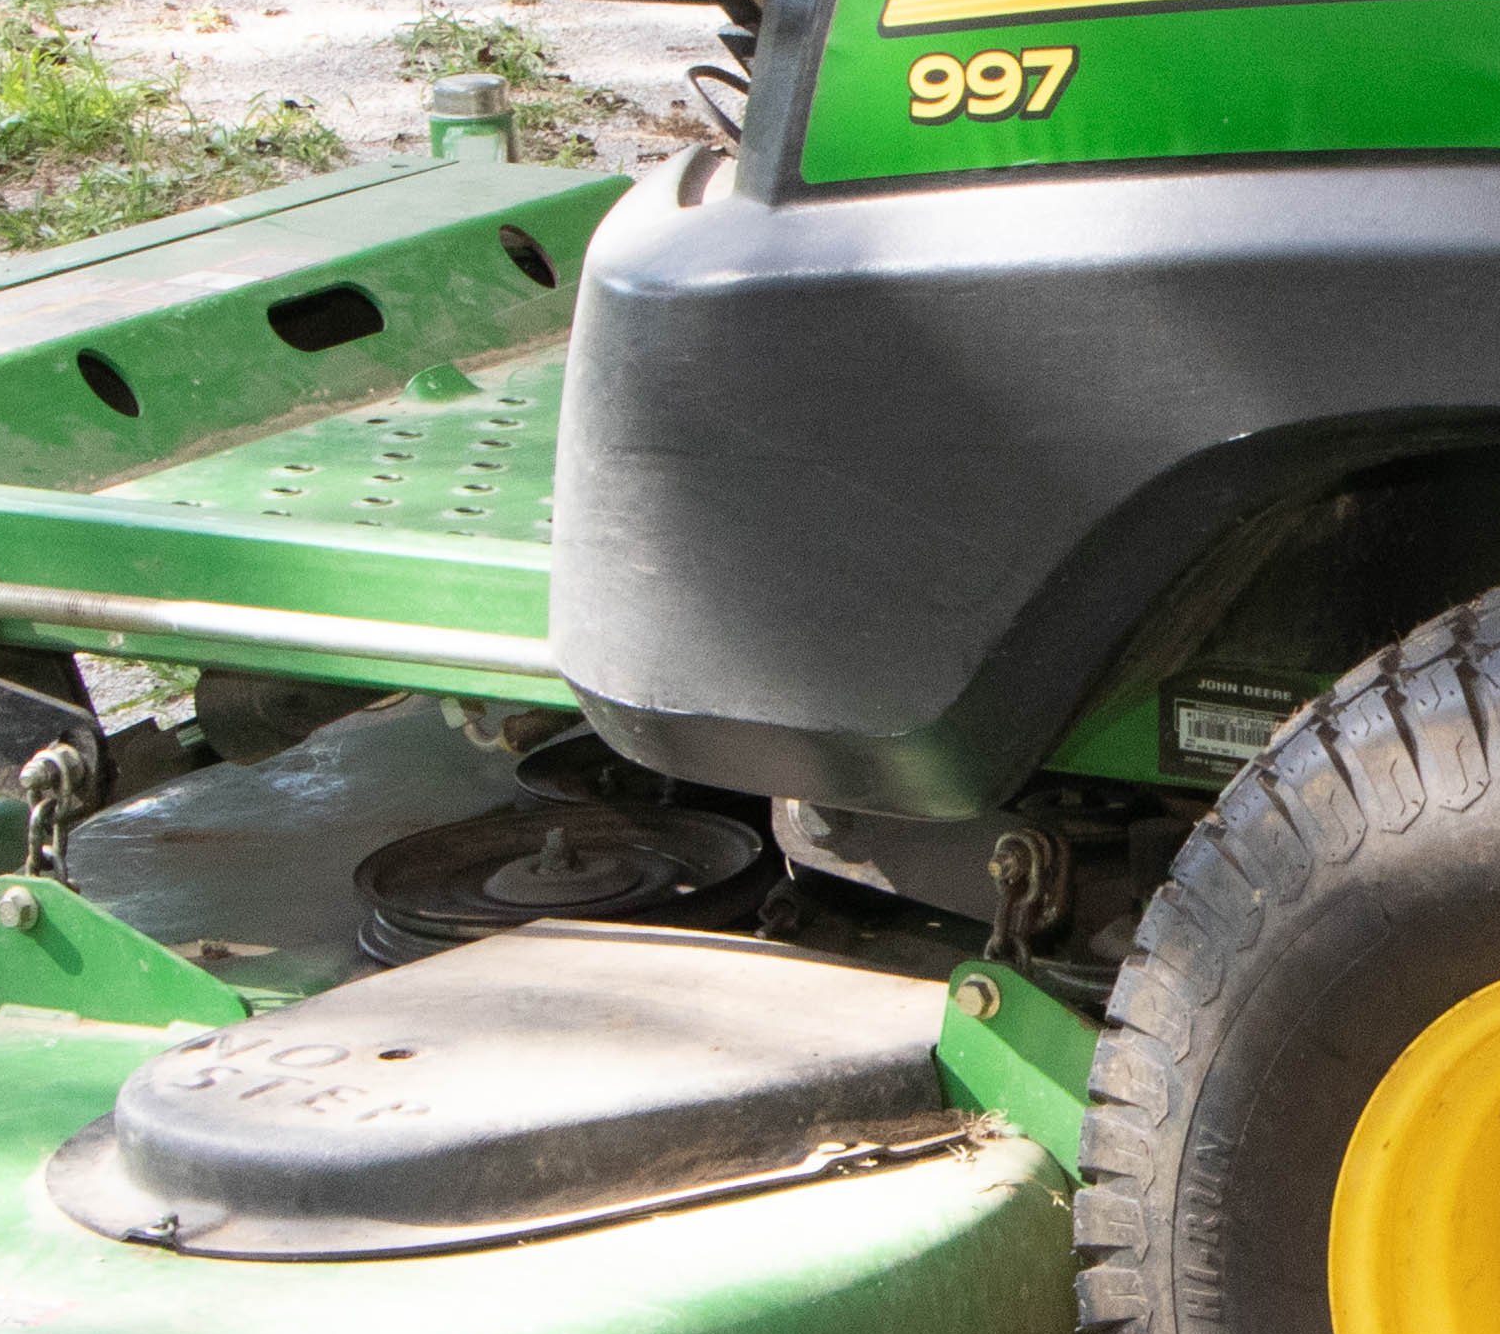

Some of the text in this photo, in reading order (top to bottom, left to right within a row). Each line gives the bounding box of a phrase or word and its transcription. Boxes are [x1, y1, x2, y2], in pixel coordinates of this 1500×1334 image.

[908, 46, 1079, 124] 997
[1197, 679, 1293, 701] JOHN DEERE
[179, 1029, 352, 1069] NO
[169, 1065, 432, 1123] STEP
[1181, 1124, 1236, 1324] HI-RUN
